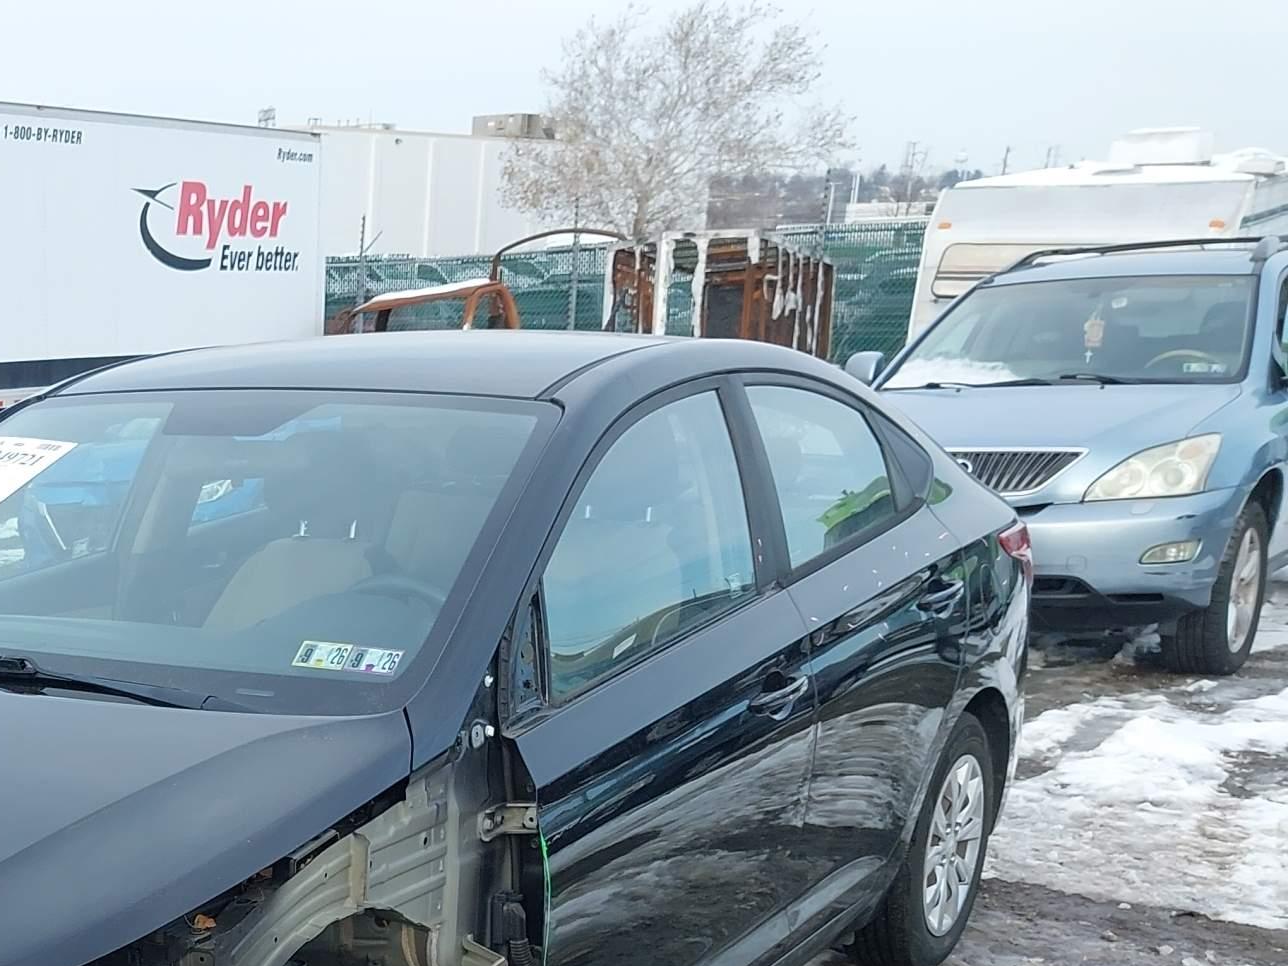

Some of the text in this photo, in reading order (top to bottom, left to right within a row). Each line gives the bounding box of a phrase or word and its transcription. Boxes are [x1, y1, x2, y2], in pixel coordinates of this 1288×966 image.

[3, 125, 83, 145] 1-800-BY-RYDER
[277, 147, 313, 163] Ryder.com
[176, 180, 288, 250] Ryder
[219, 244, 300, 272] Ever better.
